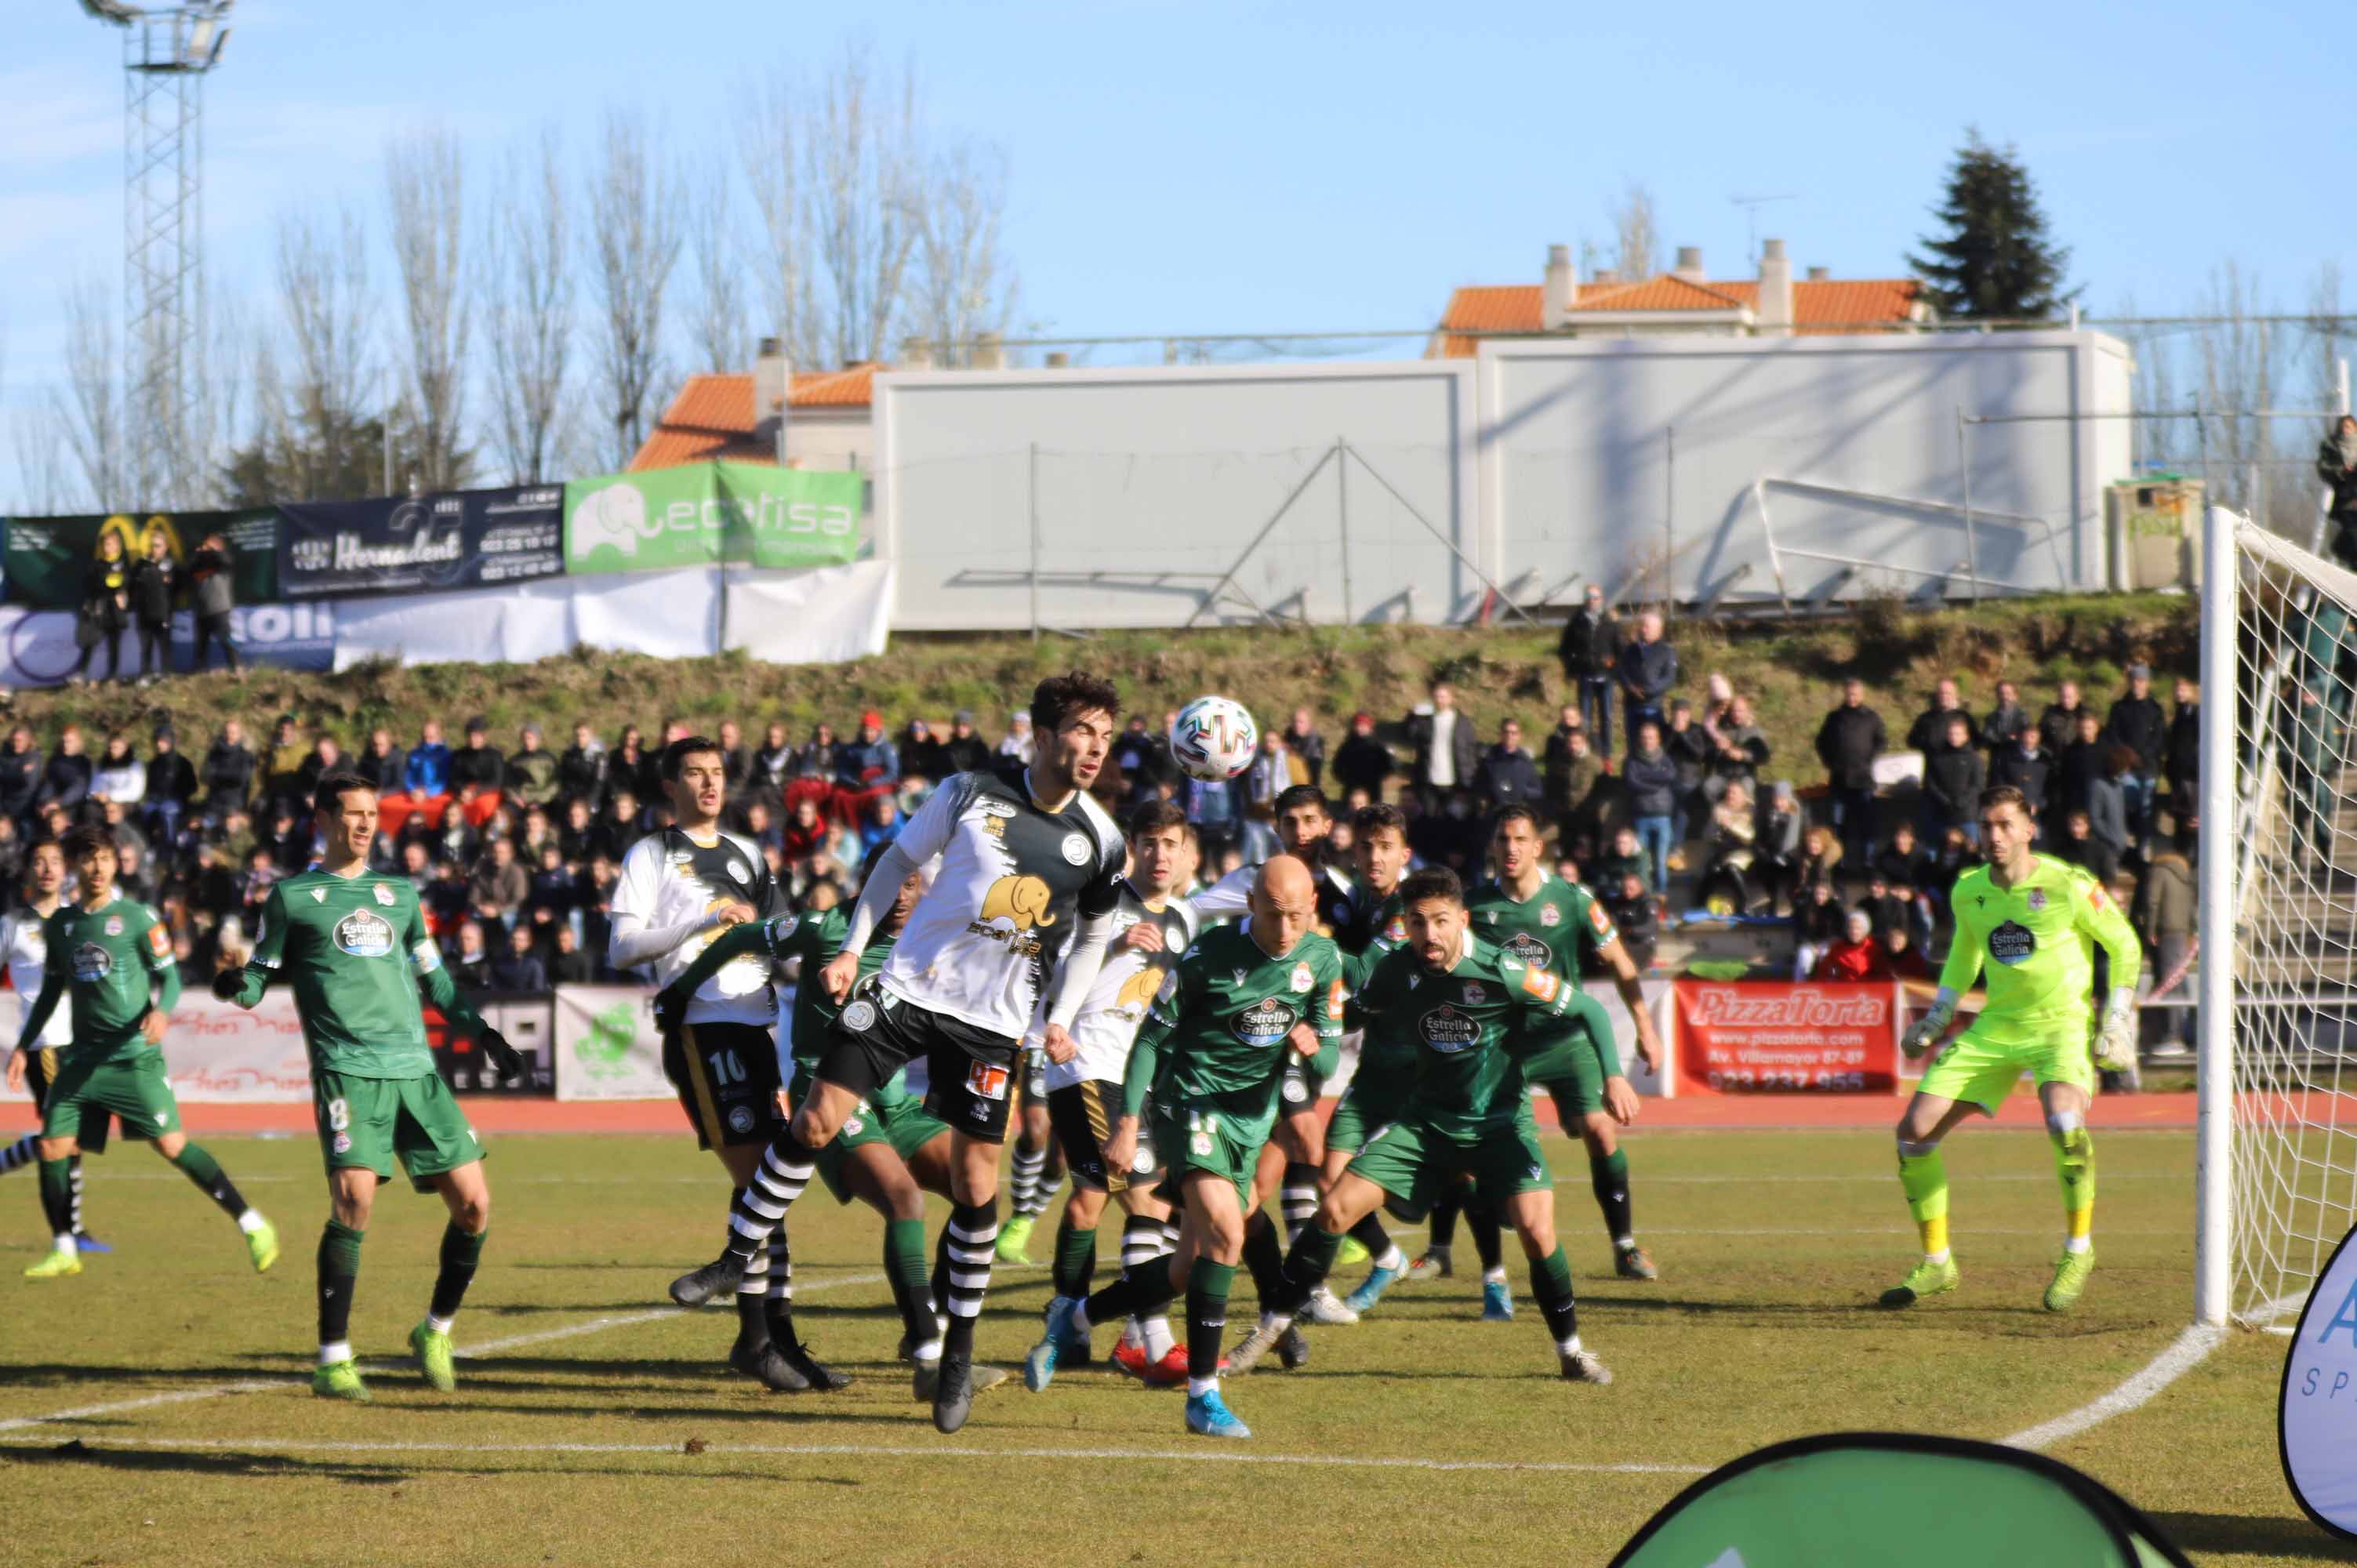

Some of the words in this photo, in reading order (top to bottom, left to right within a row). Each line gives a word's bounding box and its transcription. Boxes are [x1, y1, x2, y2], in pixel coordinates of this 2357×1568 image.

[335, 530, 461, 571] Hernadent
[342, 922, 387, 935] Estrella
[346, 934, 387, 946] Galicia
[1993, 931, 2030, 944] Estrella
[1241, 1011, 1291, 1024] Estrella
[1425, 1017, 1472, 1030] Estrella
[1240, 1022, 1284, 1036] Galicia
[1429, 1029, 1470, 1041] Galicia
[1738, 1050, 1818, 1065] Villamayor
[328, 1098, 350, 1131] 8
[2301, 1367, 2357, 1403] SP
